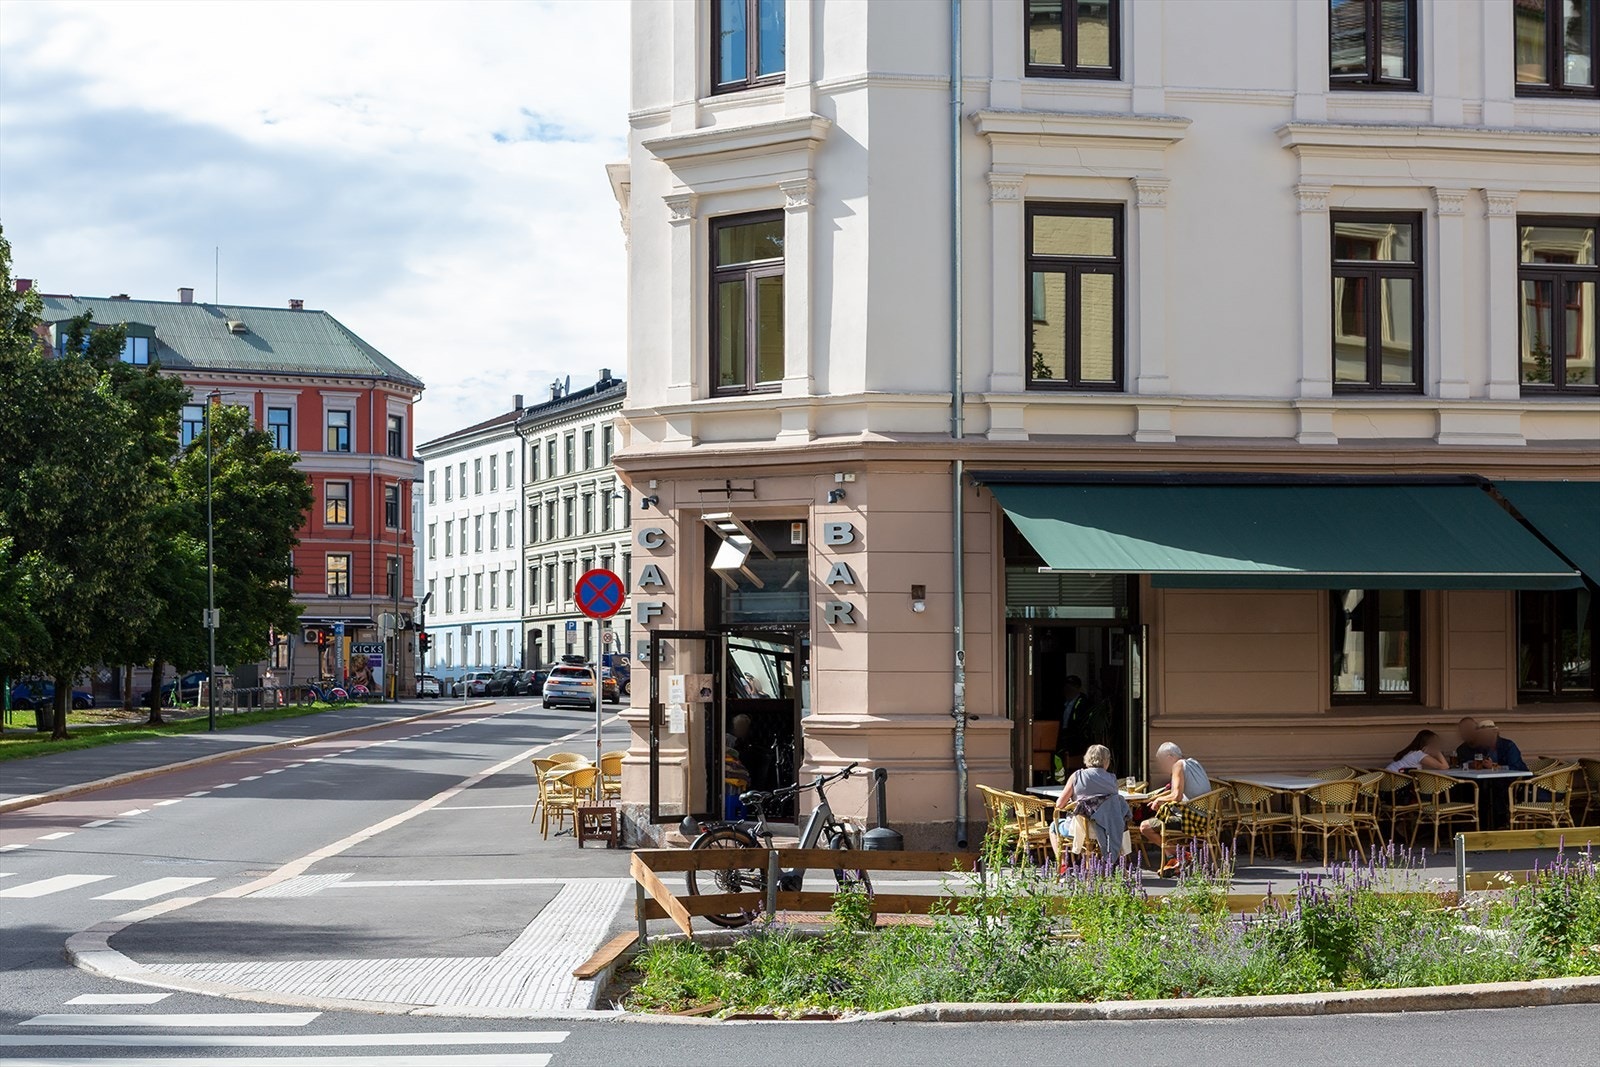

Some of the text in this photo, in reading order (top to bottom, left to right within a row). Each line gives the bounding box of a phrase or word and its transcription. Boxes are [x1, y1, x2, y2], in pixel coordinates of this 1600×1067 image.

[637, 527, 666, 662] CAFE
[824, 522, 856, 624] BAR
[352, 645, 383, 653] KICKS
